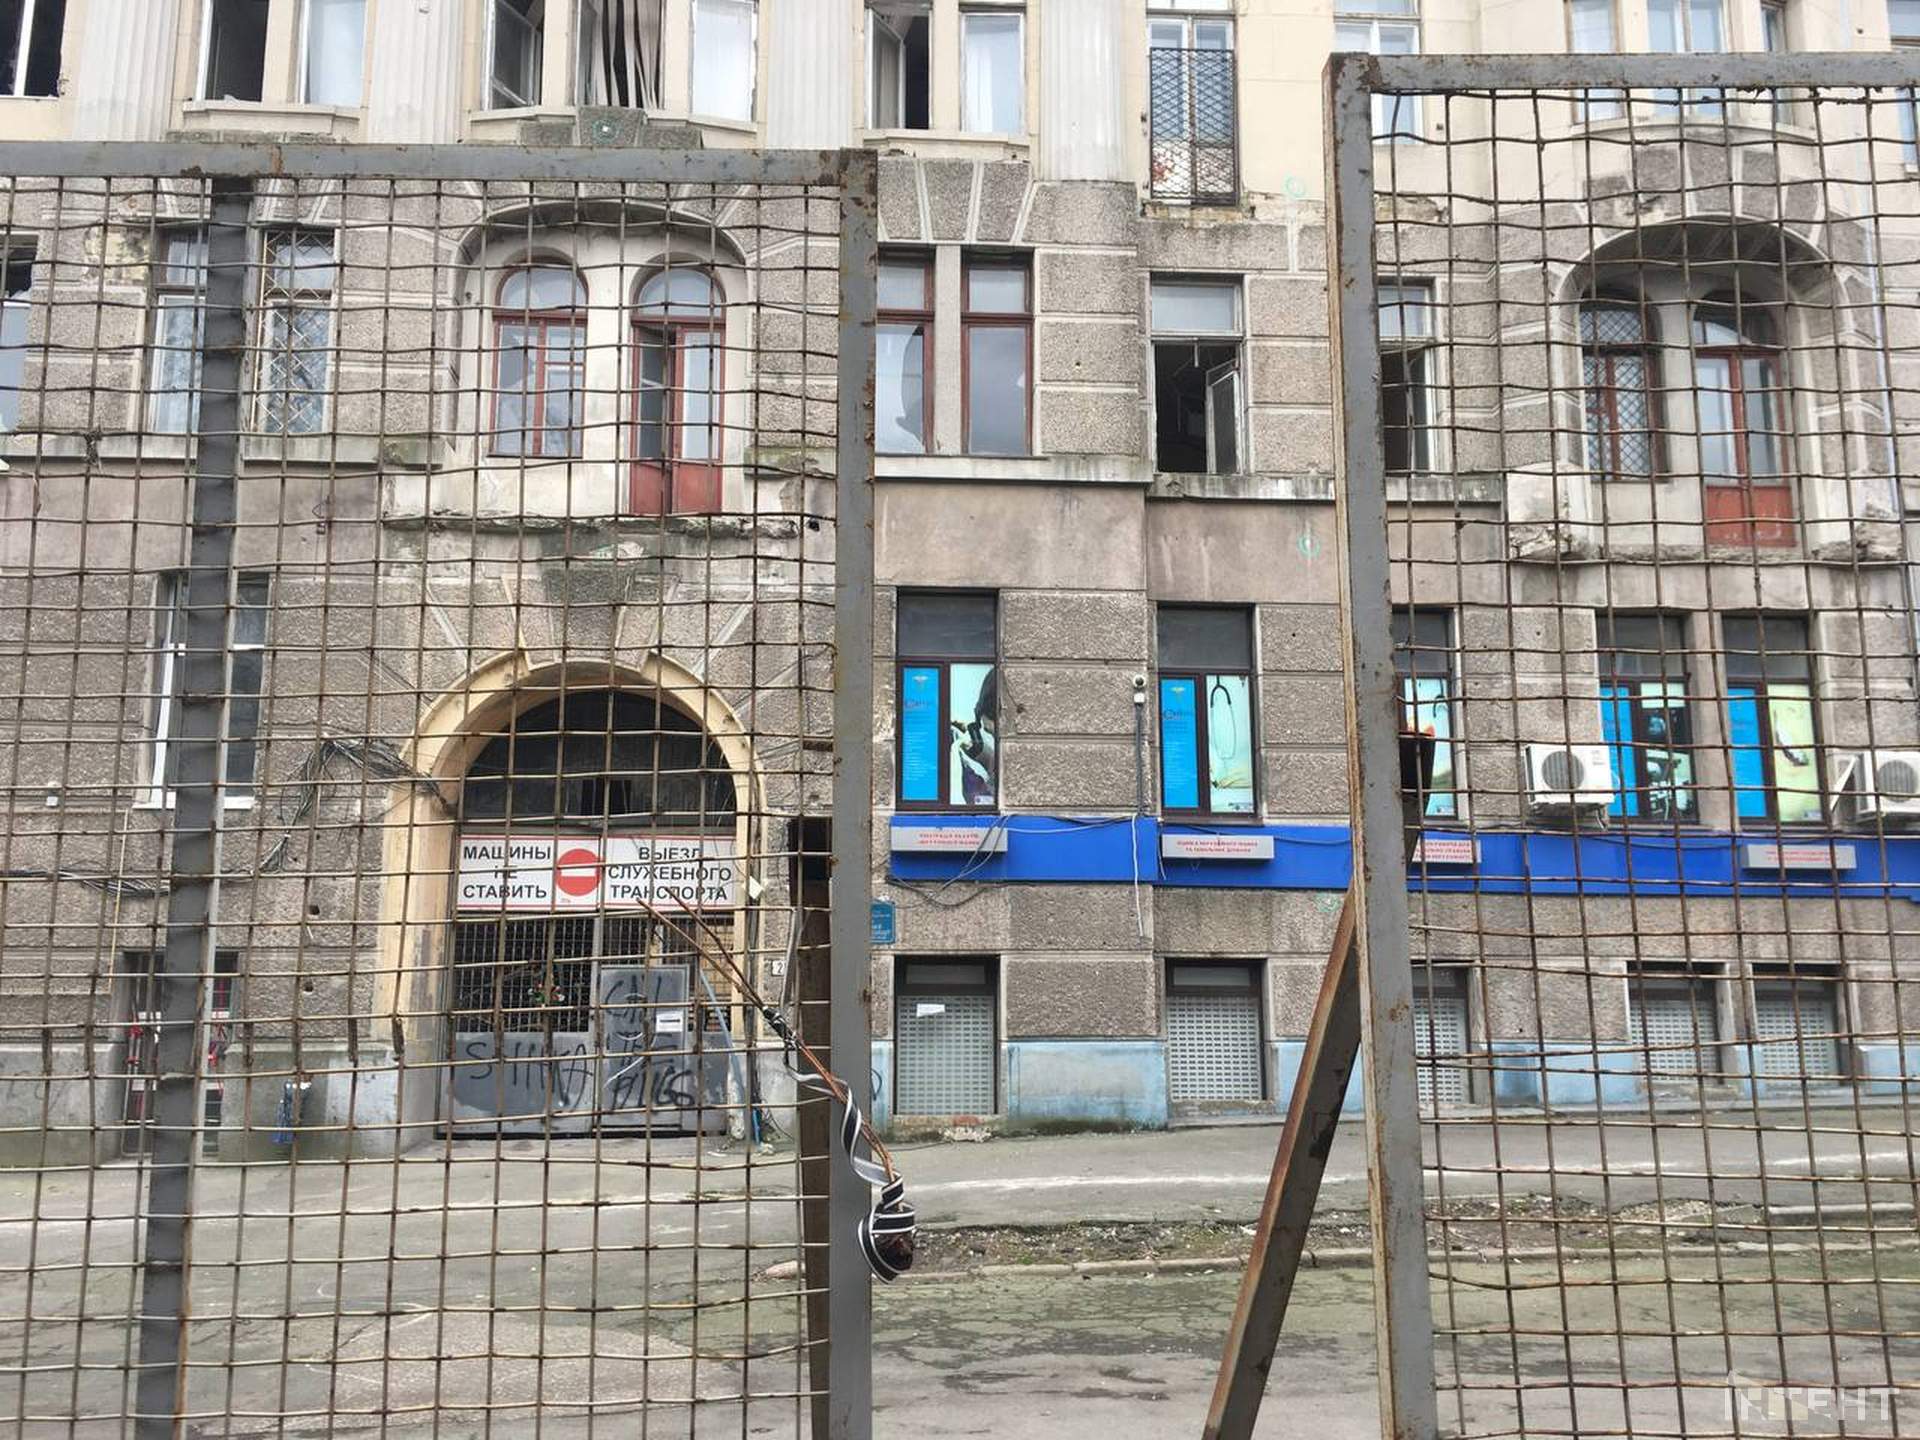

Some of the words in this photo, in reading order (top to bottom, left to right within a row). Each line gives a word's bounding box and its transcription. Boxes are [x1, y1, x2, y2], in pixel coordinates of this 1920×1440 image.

[463, 846, 551, 860] МАШИНЫ
[608, 865, 732, 881] СЛУЖЕБНОГО
[463, 884, 547, 899] СТАВИТЬ
[610, 884, 728, 900] ТРАНСПОРТА
